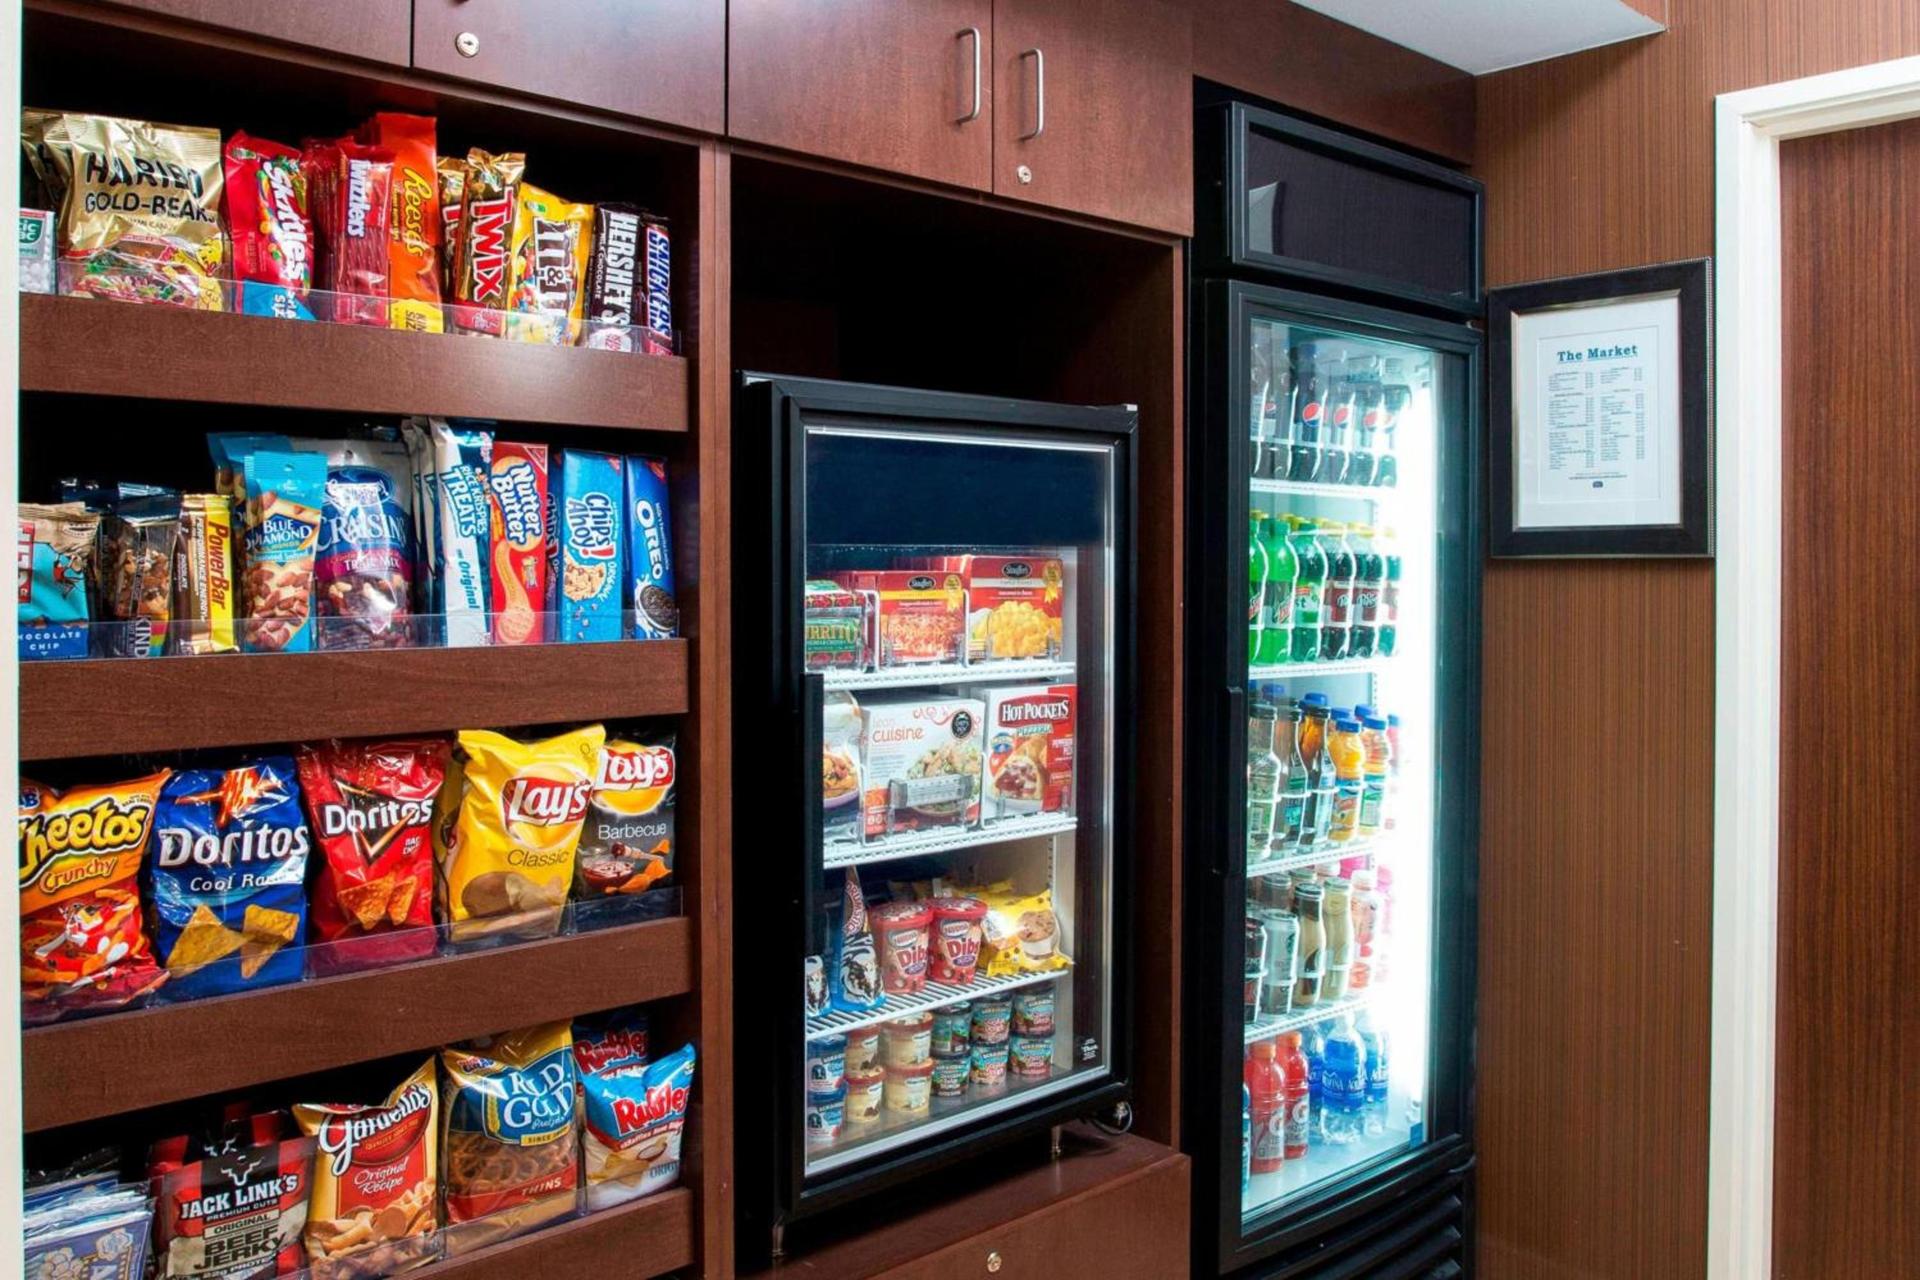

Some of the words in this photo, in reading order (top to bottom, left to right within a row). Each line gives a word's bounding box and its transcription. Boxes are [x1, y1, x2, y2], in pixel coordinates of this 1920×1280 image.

[347, 159, 371, 237] Twizzlers
[403, 167, 434, 257] Reese's
[262, 161, 307, 282] Skittles
[470, 187, 514, 302] TWIX
[595, 252, 605, 299] CHOCOLATE
[602, 212, 640, 328] HERSHEY'S
[647, 229, 671, 335] SNICKERS
[405, 310, 416, 329] SIZ
[415, 312, 427, 331] KIN
[1557, 350, 1583, 362] The
[1587, 345, 1638, 360] Market
[441, 467, 476, 537] TREATS
[460, 466, 479, 487] RICE
[471, 488, 487, 535] KRISPIES
[492, 474, 526, 544] Butter
[511, 465, 542, 535] Nutter
[587, 495, 613, 546] Chips
[264, 519, 293, 534] BLUE
[316, 508, 407, 551] CRAISIN
[636, 500, 662, 580] OREO
[209, 521, 230, 610] PowerBar
[458, 560, 481, 609] Original
[18, 631, 81, 641] HOCOLATE
[29, 643, 60, 651] CHIP
[134, 615, 151, 658] KIND
[803, 624, 858, 643] RRITO
[1001, 704, 1024, 722] HOT
[1024, 700, 1069, 720] POCKETS
[872, 727, 925, 743] cuisine
[595, 747, 670, 791] Lay's
[324, 799, 433, 835] Doritos
[508, 780, 592, 827] Lay's
[159, 820, 309, 867] Doritos
[598, 822, 668, 840] Barbecue
[43, 857, 117, 892] Crunchy
[507, 849, 569, 868] Classic
[190, 874, 235, 891] Cool
[575, 1029, 648, 1073] Ruffle
[354, 1156, 410, 1184] Original
[358, 1176, 404, 1194] Recipe
[521, 1177, 562, 1196] THINS
[181, 1192, 231, 1219] JACK
[235, 1174, 298, 1207] LINK'S
[206, 1206, 251, 1221] PREMIUM
[253, 1199, 278, 1210] CUTS
[204, 1224, 279, 1256] BEEF
[213, 1214, 270, 1234] ORIGINAL
[193, 1231, 287, 1270] JERKY
